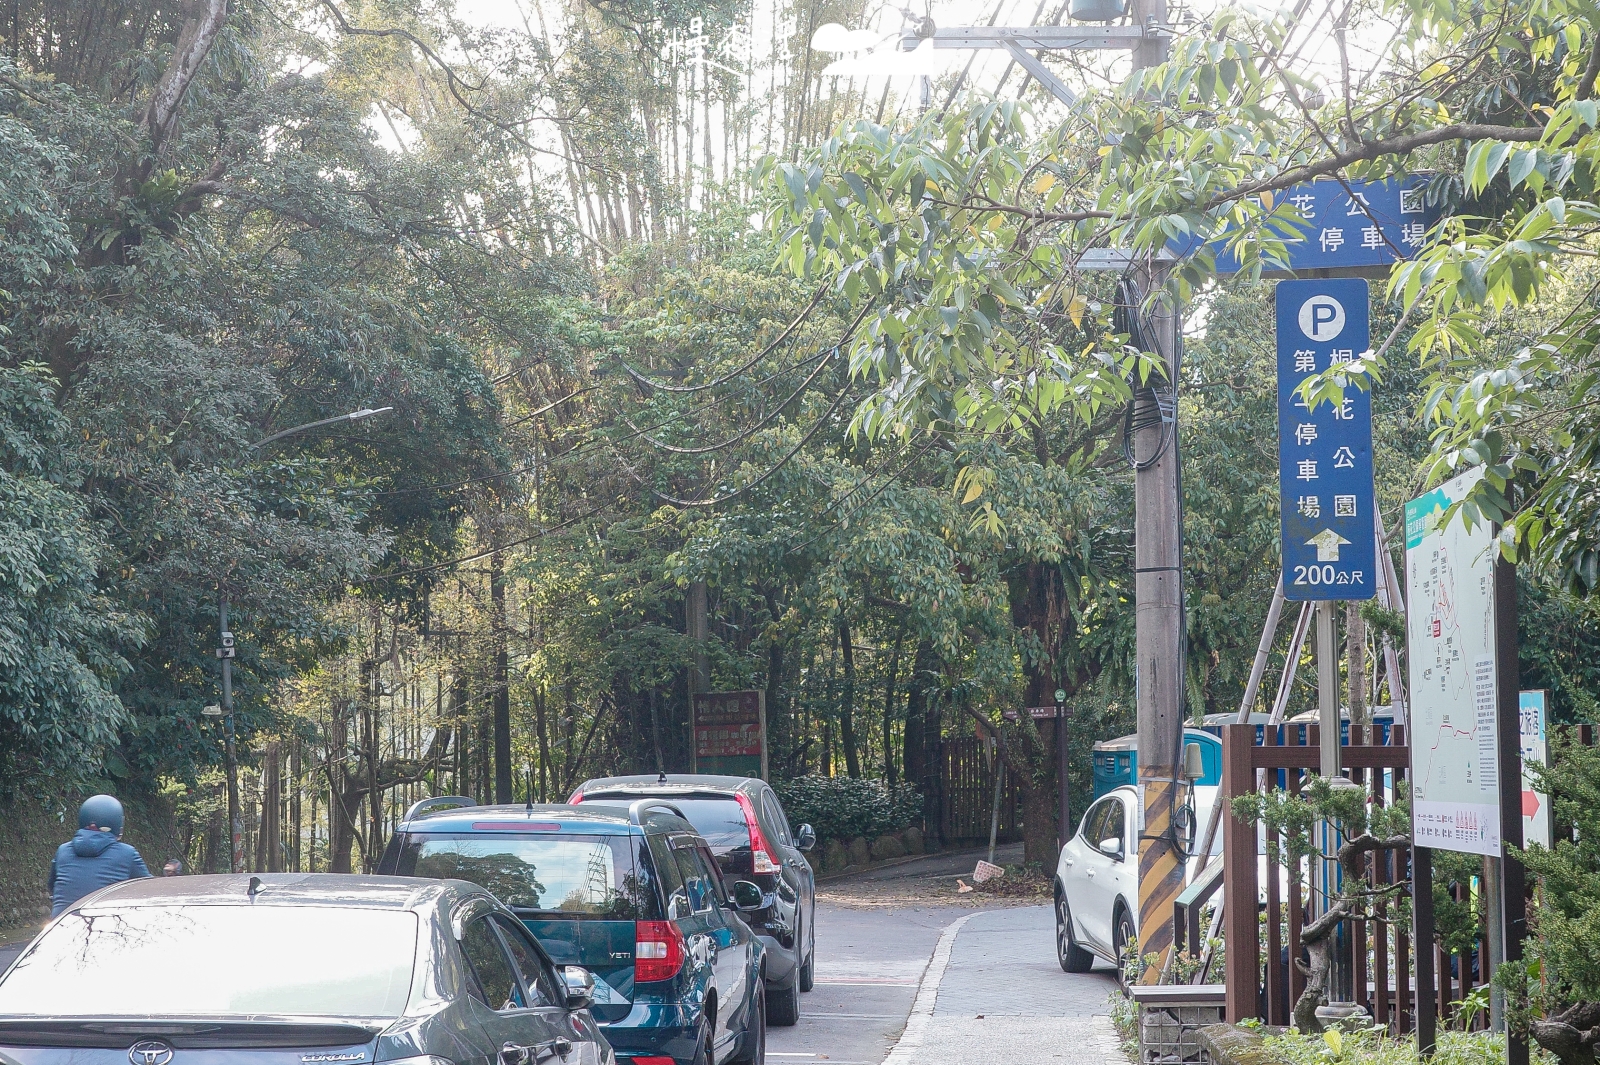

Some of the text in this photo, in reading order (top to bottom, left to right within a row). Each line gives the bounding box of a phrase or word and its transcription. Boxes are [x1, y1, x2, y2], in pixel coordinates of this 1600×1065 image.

[1245, 189, 1425, 220] 花公園
[1312, 303, 1337, 336] P
[301, 1052, 365, 1062] COROLLA
